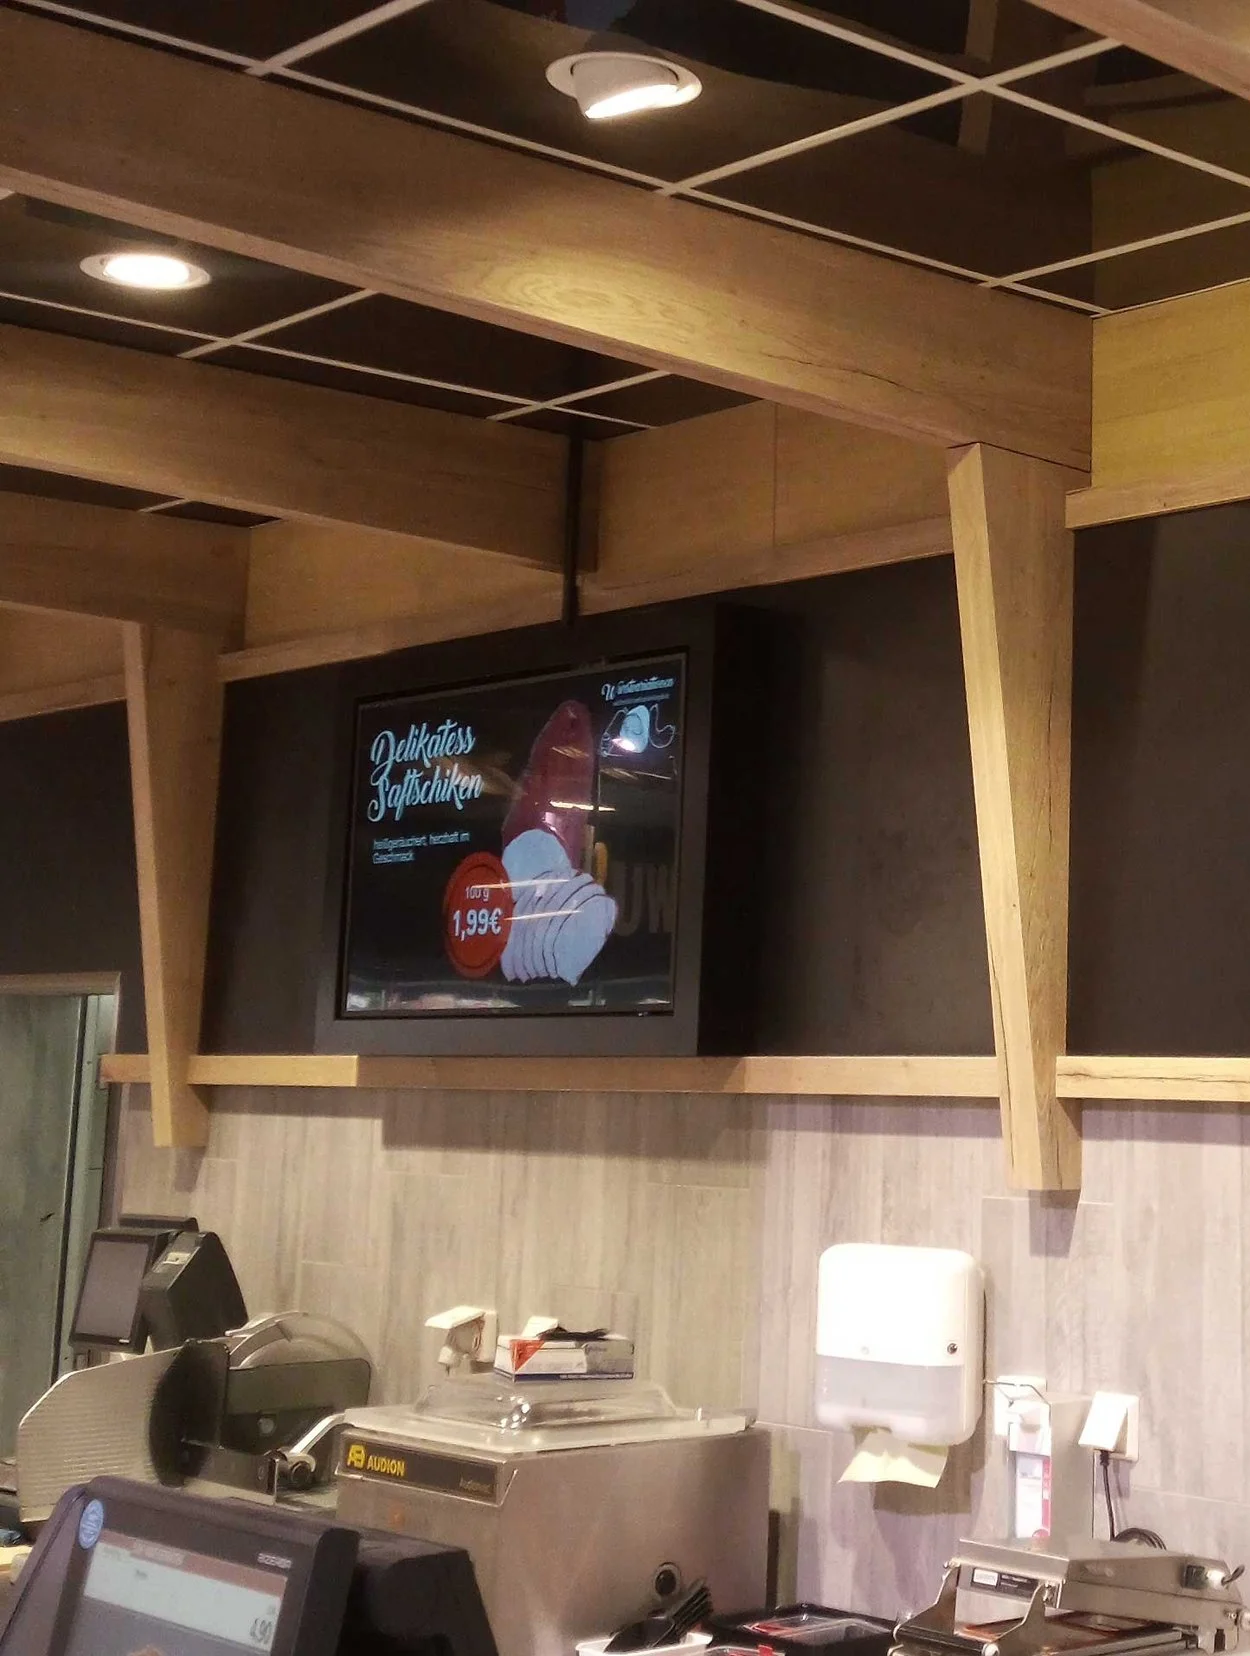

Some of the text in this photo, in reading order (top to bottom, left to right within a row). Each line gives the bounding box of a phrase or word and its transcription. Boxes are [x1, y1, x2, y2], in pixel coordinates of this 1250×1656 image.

[370, 718, 477, 786] Delikatess
[465, 886, 481, 899] 100
[453, 907, 502, 942] 1,99€
[366, 1455, 406, 1477] AUDION
